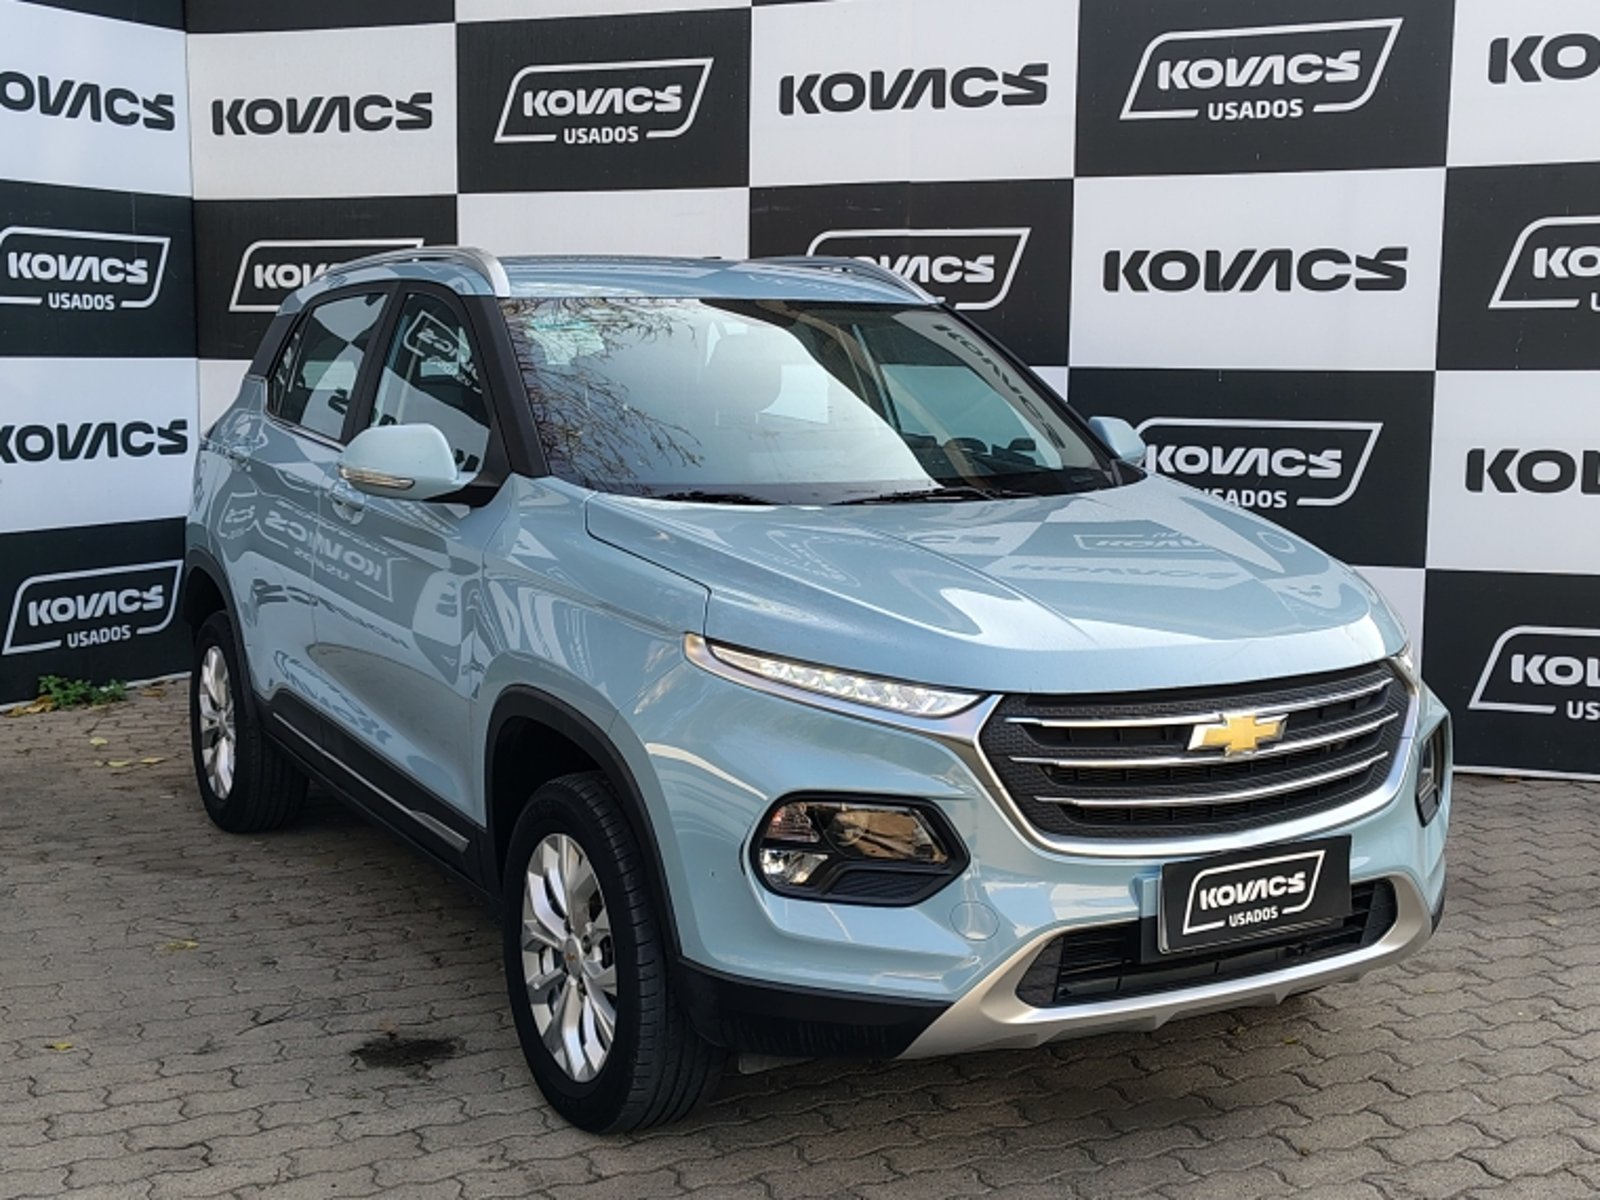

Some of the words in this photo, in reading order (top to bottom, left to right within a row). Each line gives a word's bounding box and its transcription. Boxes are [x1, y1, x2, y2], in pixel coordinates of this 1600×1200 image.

[1158, 50, 1360, 91] KOVACS
[523, 84, 682, 118] KOVACS
[779, 63, 1049, 116] KOVACS
[212, 92, 432, 136] KOVACS
[1208, 98, 1304, 121] USADOS
[563, 125, 639, 144] USADOS
[8, 251, 148, 284] KOVACS
[1103, 246, 1408, 293] KOVACS
[49, 292, 115, 311] USADOS
[1145, 445, 1342, 478] KOVACS
[28, 585, 165, 626] KOVACS
[67, 624, 131, 649] USADOS
[1199, 871, 1306, 910] KOVACS
[1228, 905, 1278, 927] USADOS
